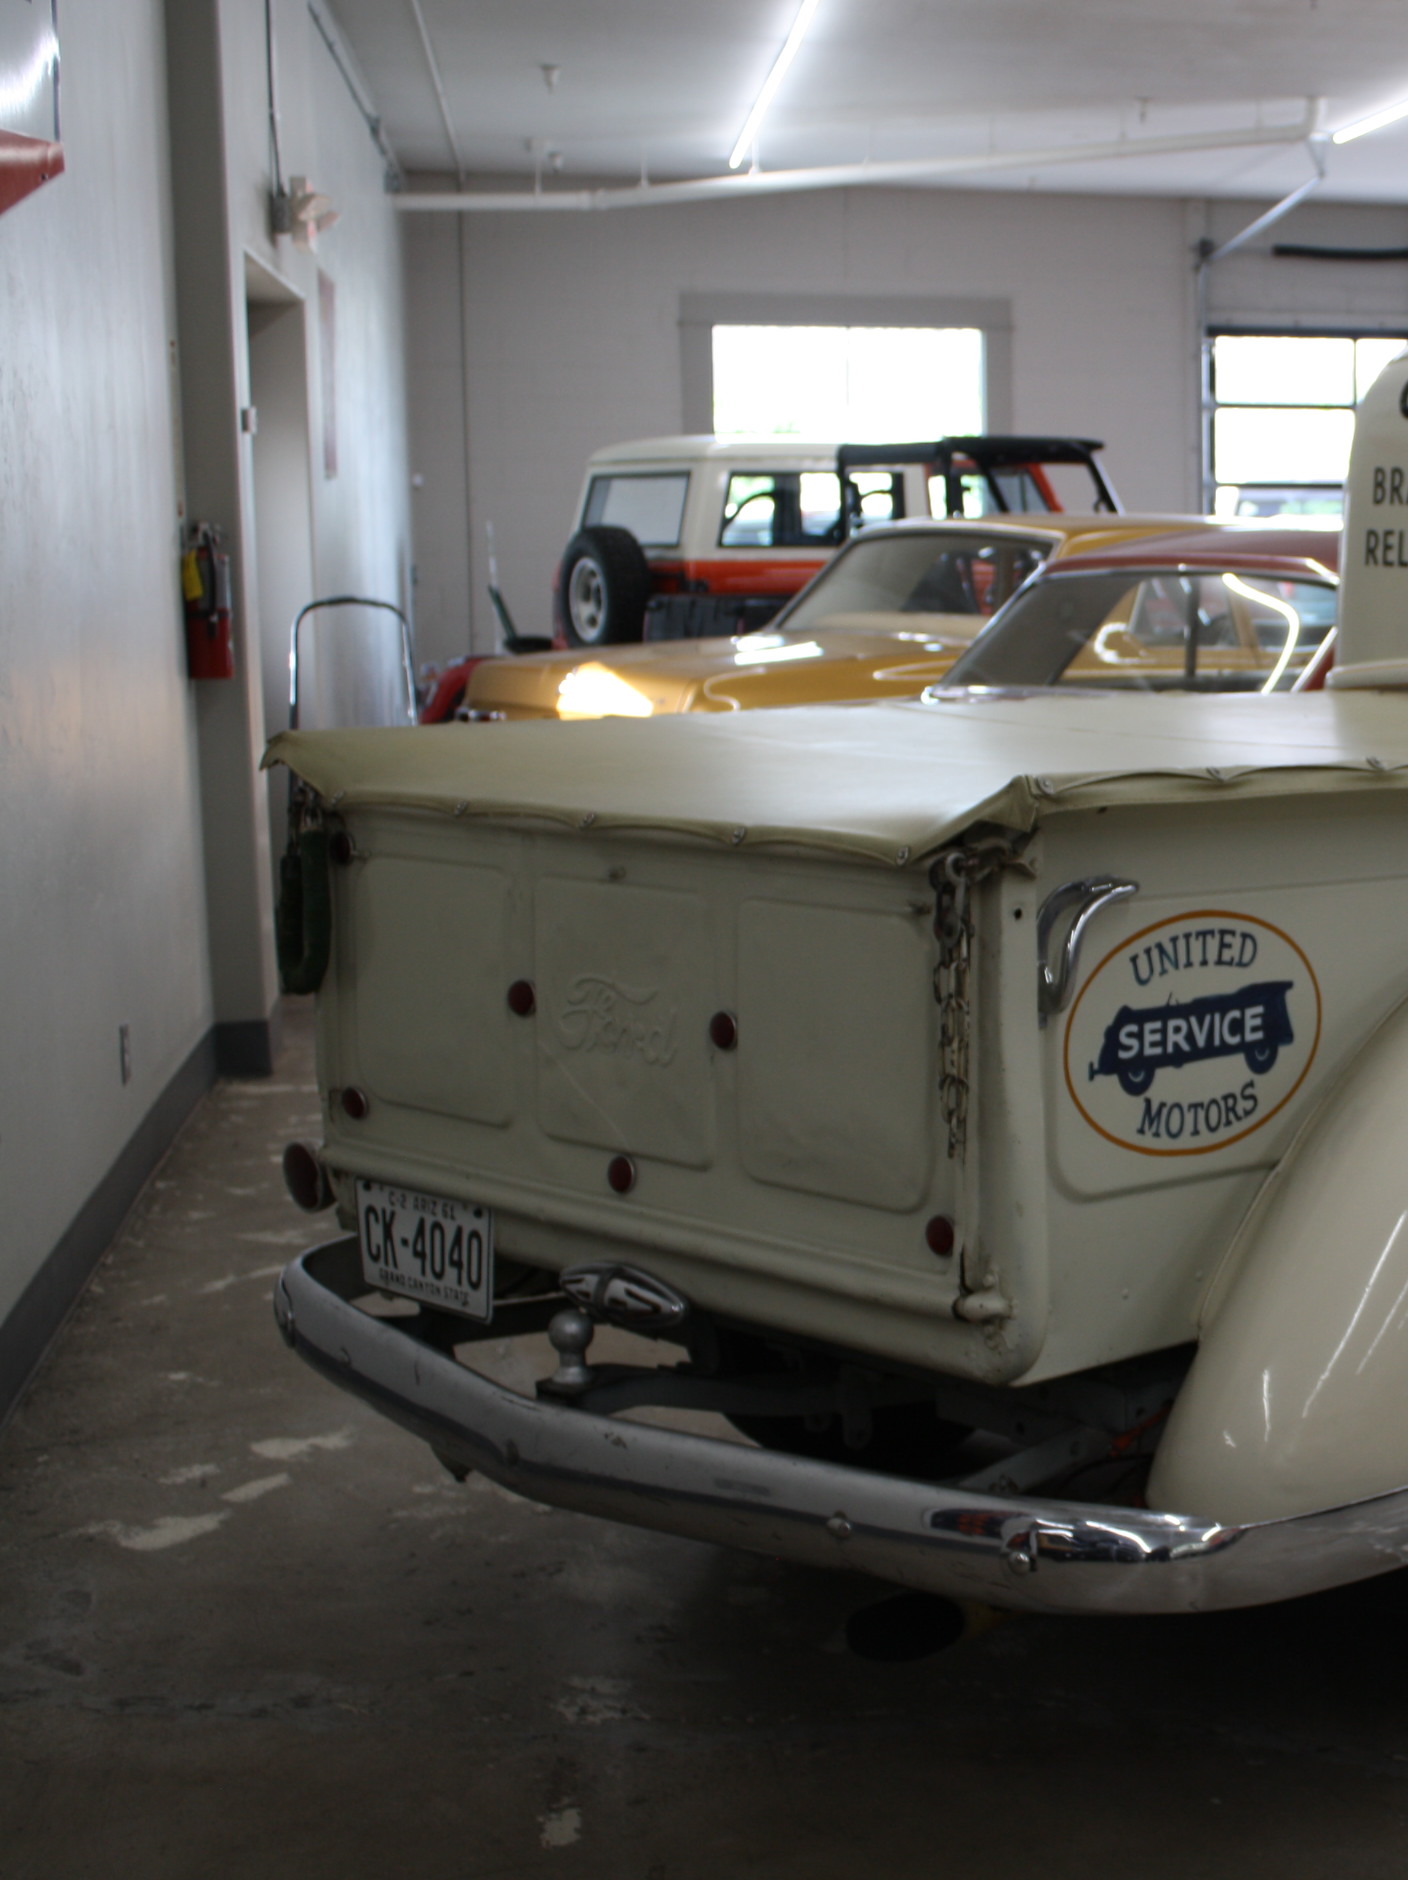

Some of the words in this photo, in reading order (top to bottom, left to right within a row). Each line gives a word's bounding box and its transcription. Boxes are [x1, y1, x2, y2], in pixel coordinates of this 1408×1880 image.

[1129, 928, 1258, 986] UNITED
[1117, 1005, 1265, 1059] SERVICE
[1137, 1080, 1258, 1139] MOTORS
[364, 1203, 483, 1291] CK-4040
